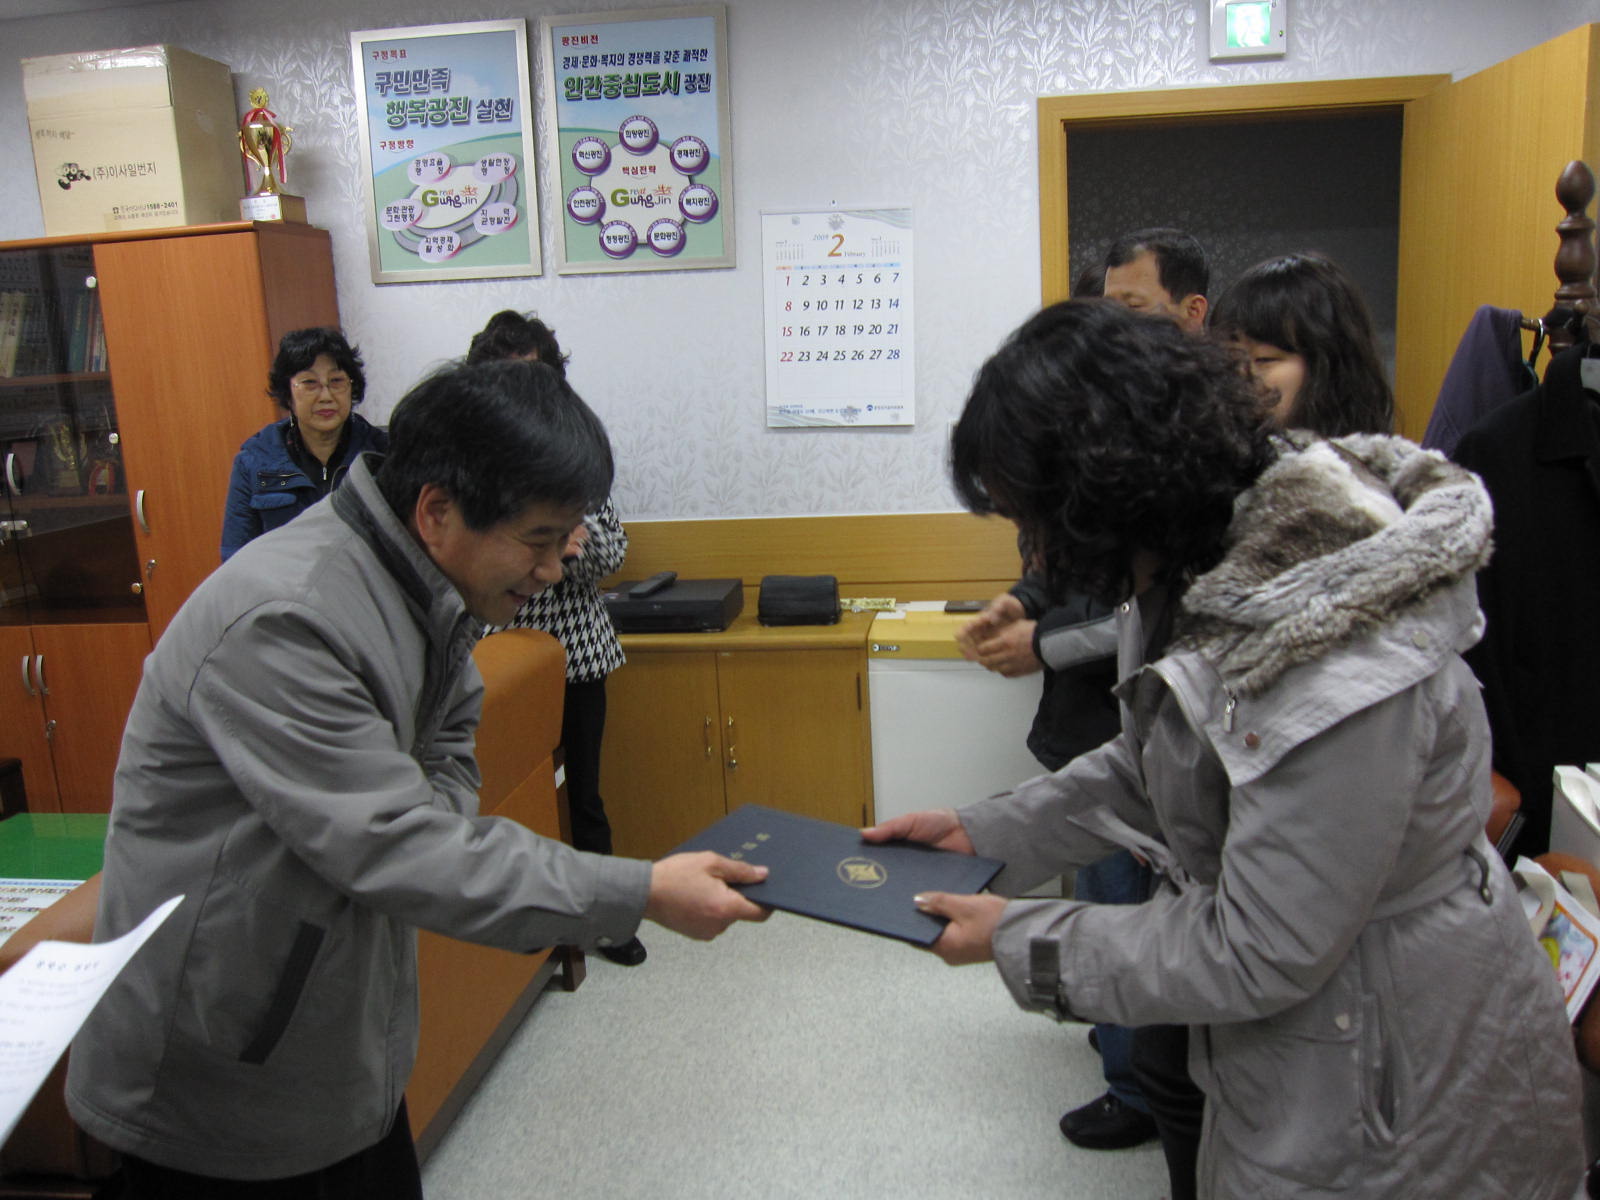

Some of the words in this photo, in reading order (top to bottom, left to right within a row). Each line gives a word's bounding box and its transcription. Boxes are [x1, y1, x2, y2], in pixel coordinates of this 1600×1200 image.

[561, 35, 598, 46] 광진비전
[372, 49, 407, 60] 구정목표
[664, 50, 680, 63] 갖춘
[375, 68, 450, 95] 구민만족
[564, 71, 680, 101] 인간중심도시
[684, 72, 711, 94] 광진
[386, 96, 470, 128] 행복광진
[476, 98, 513, 121] 실현
[622, 165, 656, 175] 핵심전략
[828, 233, 845, 257] 2
[786, 276, 790, 286] 1
[802, 275, 809, 285] 2
[821, 275, 826, 284] 3
[838, 275, 845, 284] 4
[856, 274, 862, 284] 5
[874, 273, 880, 283] 6
[893, 273, 899, 283] 7
[785, 301, 792, 311] 8
[803, 301, 809, 311] 9
[817, 300, 827, 310] 10
[836, 300, 843, 310] 11
[853, 299, 863, 309] 12
[871, 299, 880, 309] 13
[889, 299, 899, 308] 14
[783, 327, 792, 336] 15
[800, 326, 810, 336] 16
[818, 326, 828, 335] 17
[836, 325, 846, 335] 18
[854, 325, 863, 335] 19
[869, 324, 881, 334] 20
[887, 324, 898, 334] 21
[780, 352, 793, 362] 22
[798, 352, 810, 361] 23
[816, 351, 828, 360] 24
[834, 351, 846, 360] 25
[852, 350, 863, 360] 26
[869, 350, 882, 360] 27
[887, 350, 900, 359] 28
